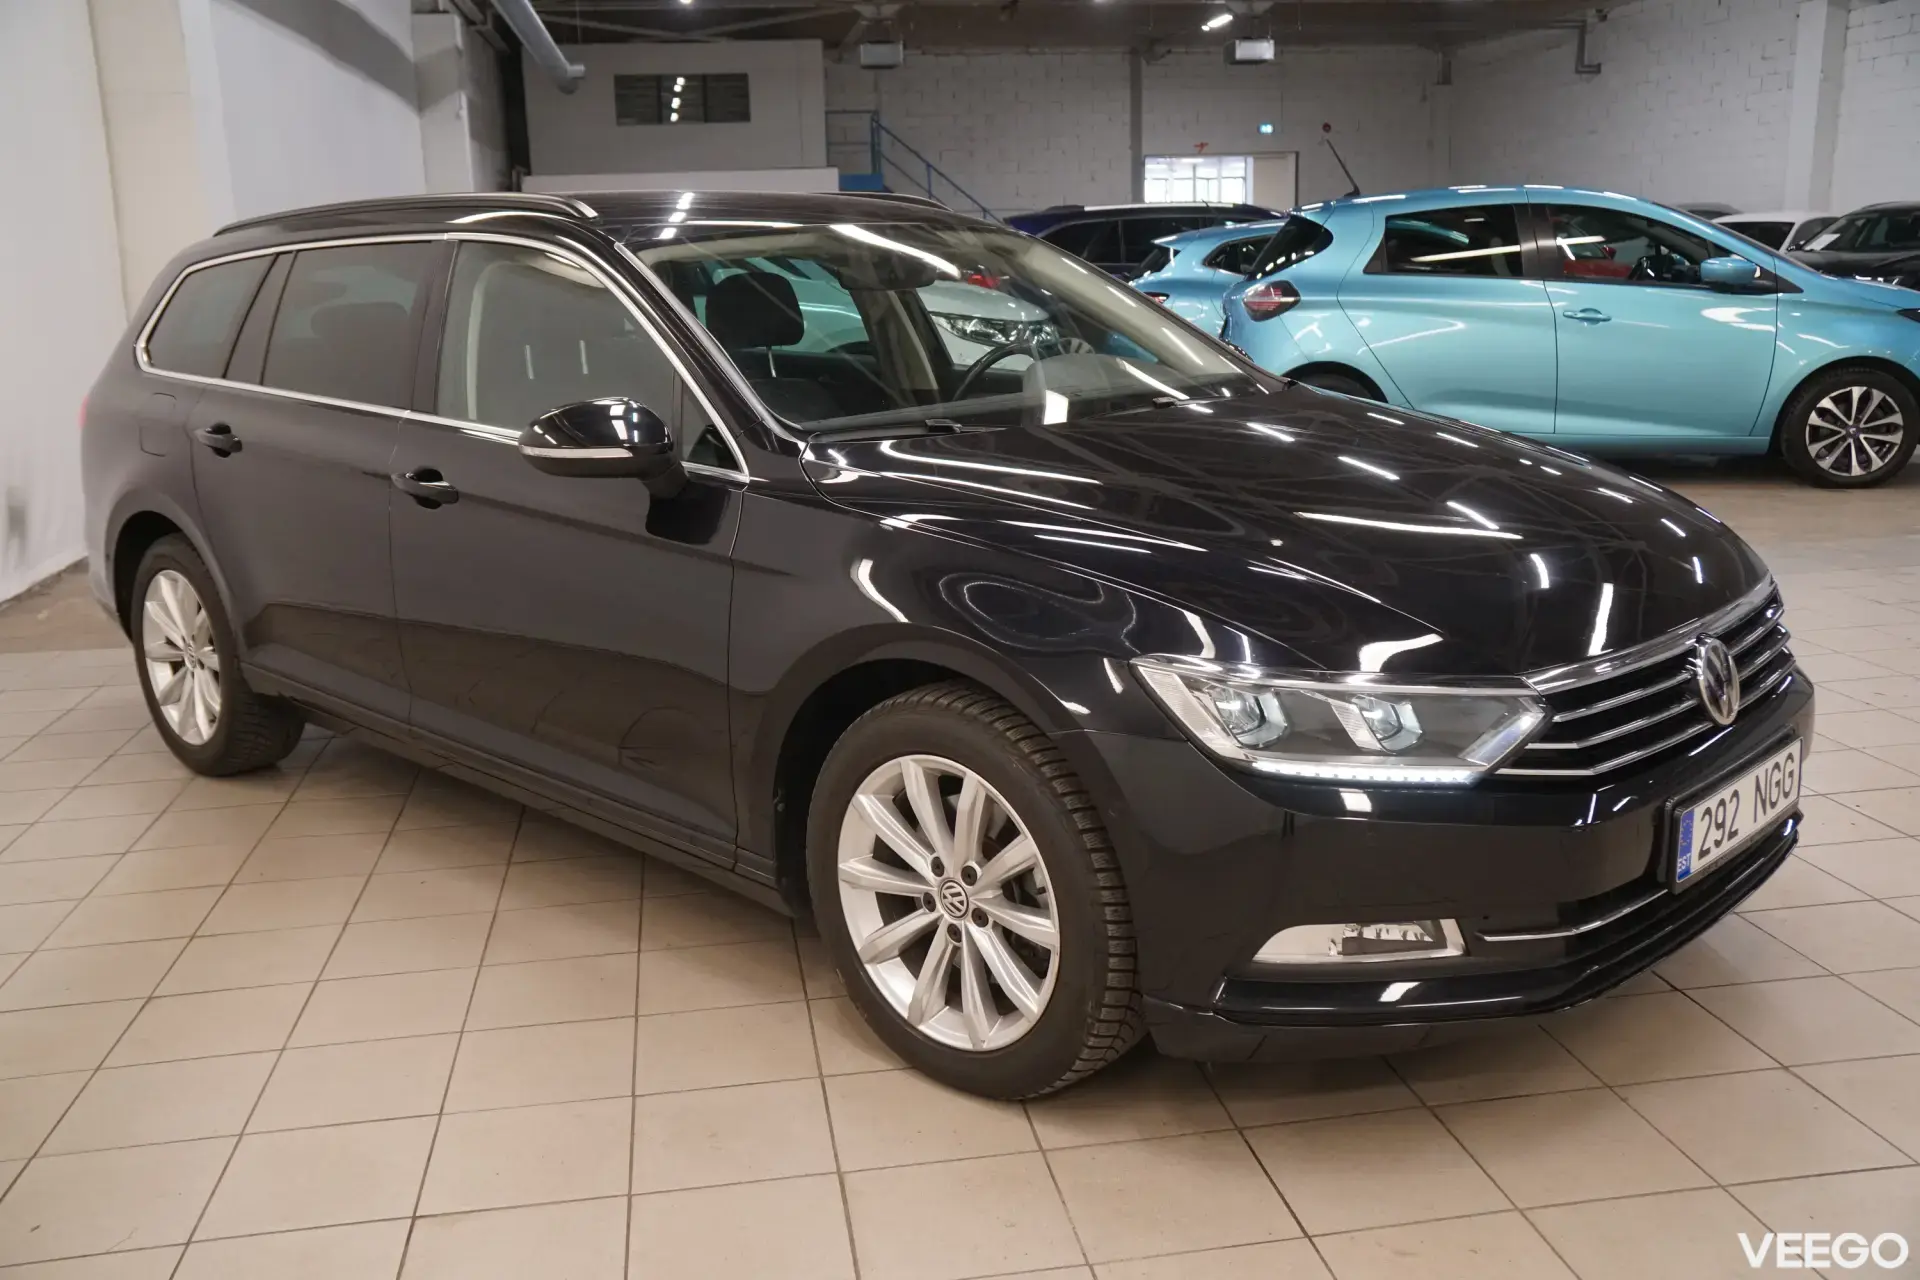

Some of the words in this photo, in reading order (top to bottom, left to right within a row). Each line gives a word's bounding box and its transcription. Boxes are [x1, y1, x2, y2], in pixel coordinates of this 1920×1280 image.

[1697, 789, 1740, 861] 292
[1753, 752, 1795, 823] NGG
[1677, 852, 1692, 873] EST
